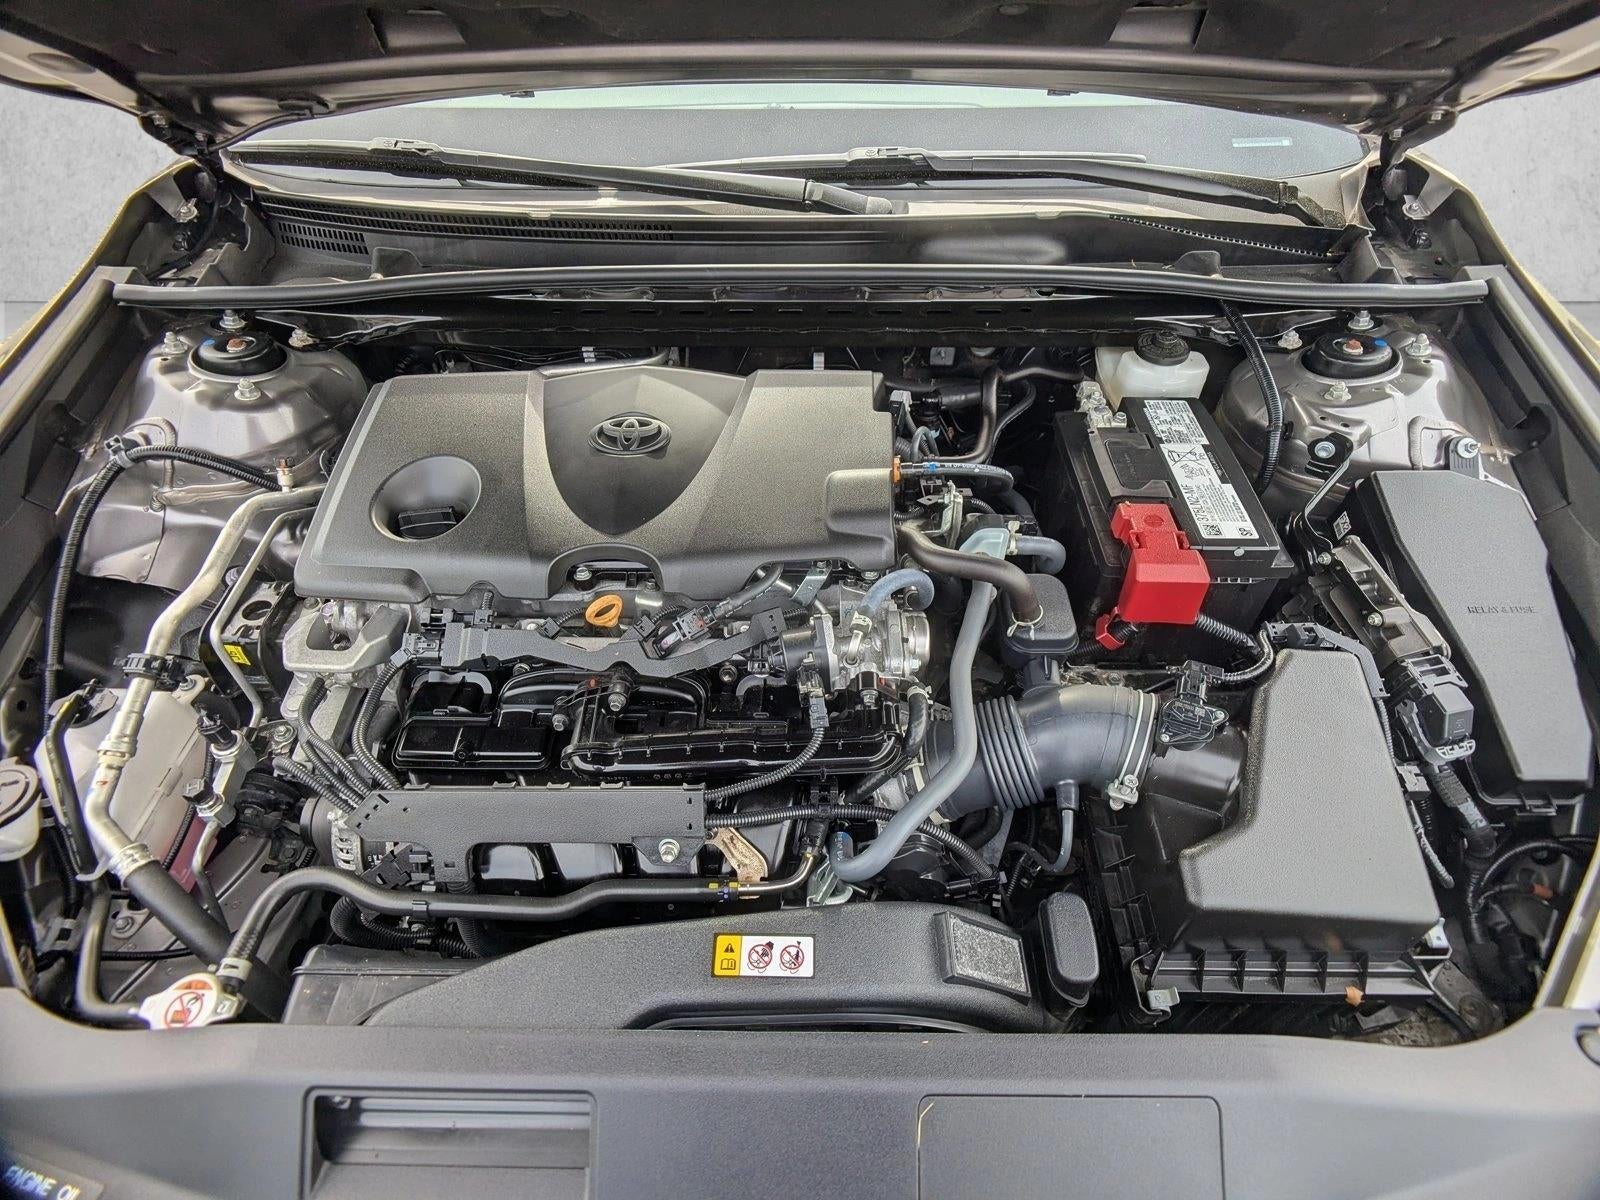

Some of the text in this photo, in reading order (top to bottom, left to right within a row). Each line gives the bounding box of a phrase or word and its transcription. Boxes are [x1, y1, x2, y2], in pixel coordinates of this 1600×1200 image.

[1467, 606, 1499, 614] RELAY
[1509, 606, 1538, 614] FUSE
[3, 1165, 57, 1196] ENGINE
